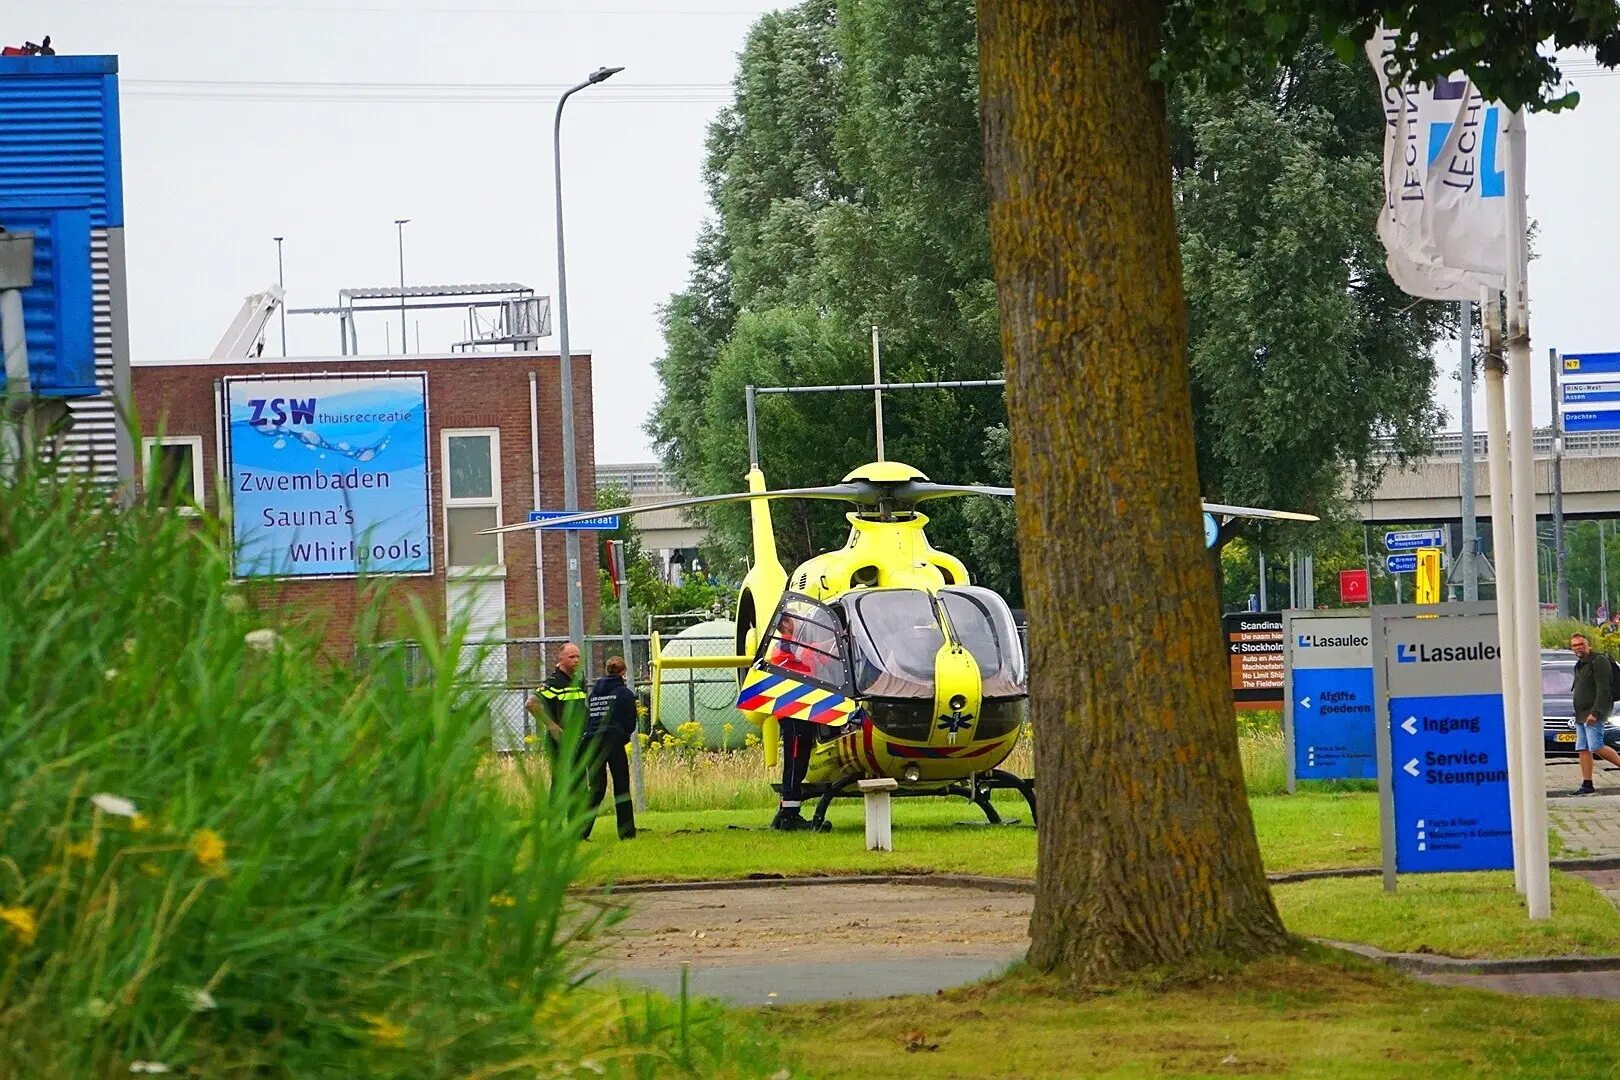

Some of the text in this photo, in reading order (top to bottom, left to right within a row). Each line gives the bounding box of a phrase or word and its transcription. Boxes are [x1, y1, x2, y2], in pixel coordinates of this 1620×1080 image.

[247, 397, 412, 426] ZSW thuisrecreatie
[239, 467, 390, 492] Zwembaden
[262, 504, 355, 528] Sauna's
[290, 539, 422, 565] Whirlpools
[1312, 634, 1369, 648] Lasaulec
[1320, 691, 1356, 703] Afgifte
[1320, 704, 1371, 716] goederen
[1423, 716, 1480, 733] Ingang
[1425, 750, 1488, 766] Service
